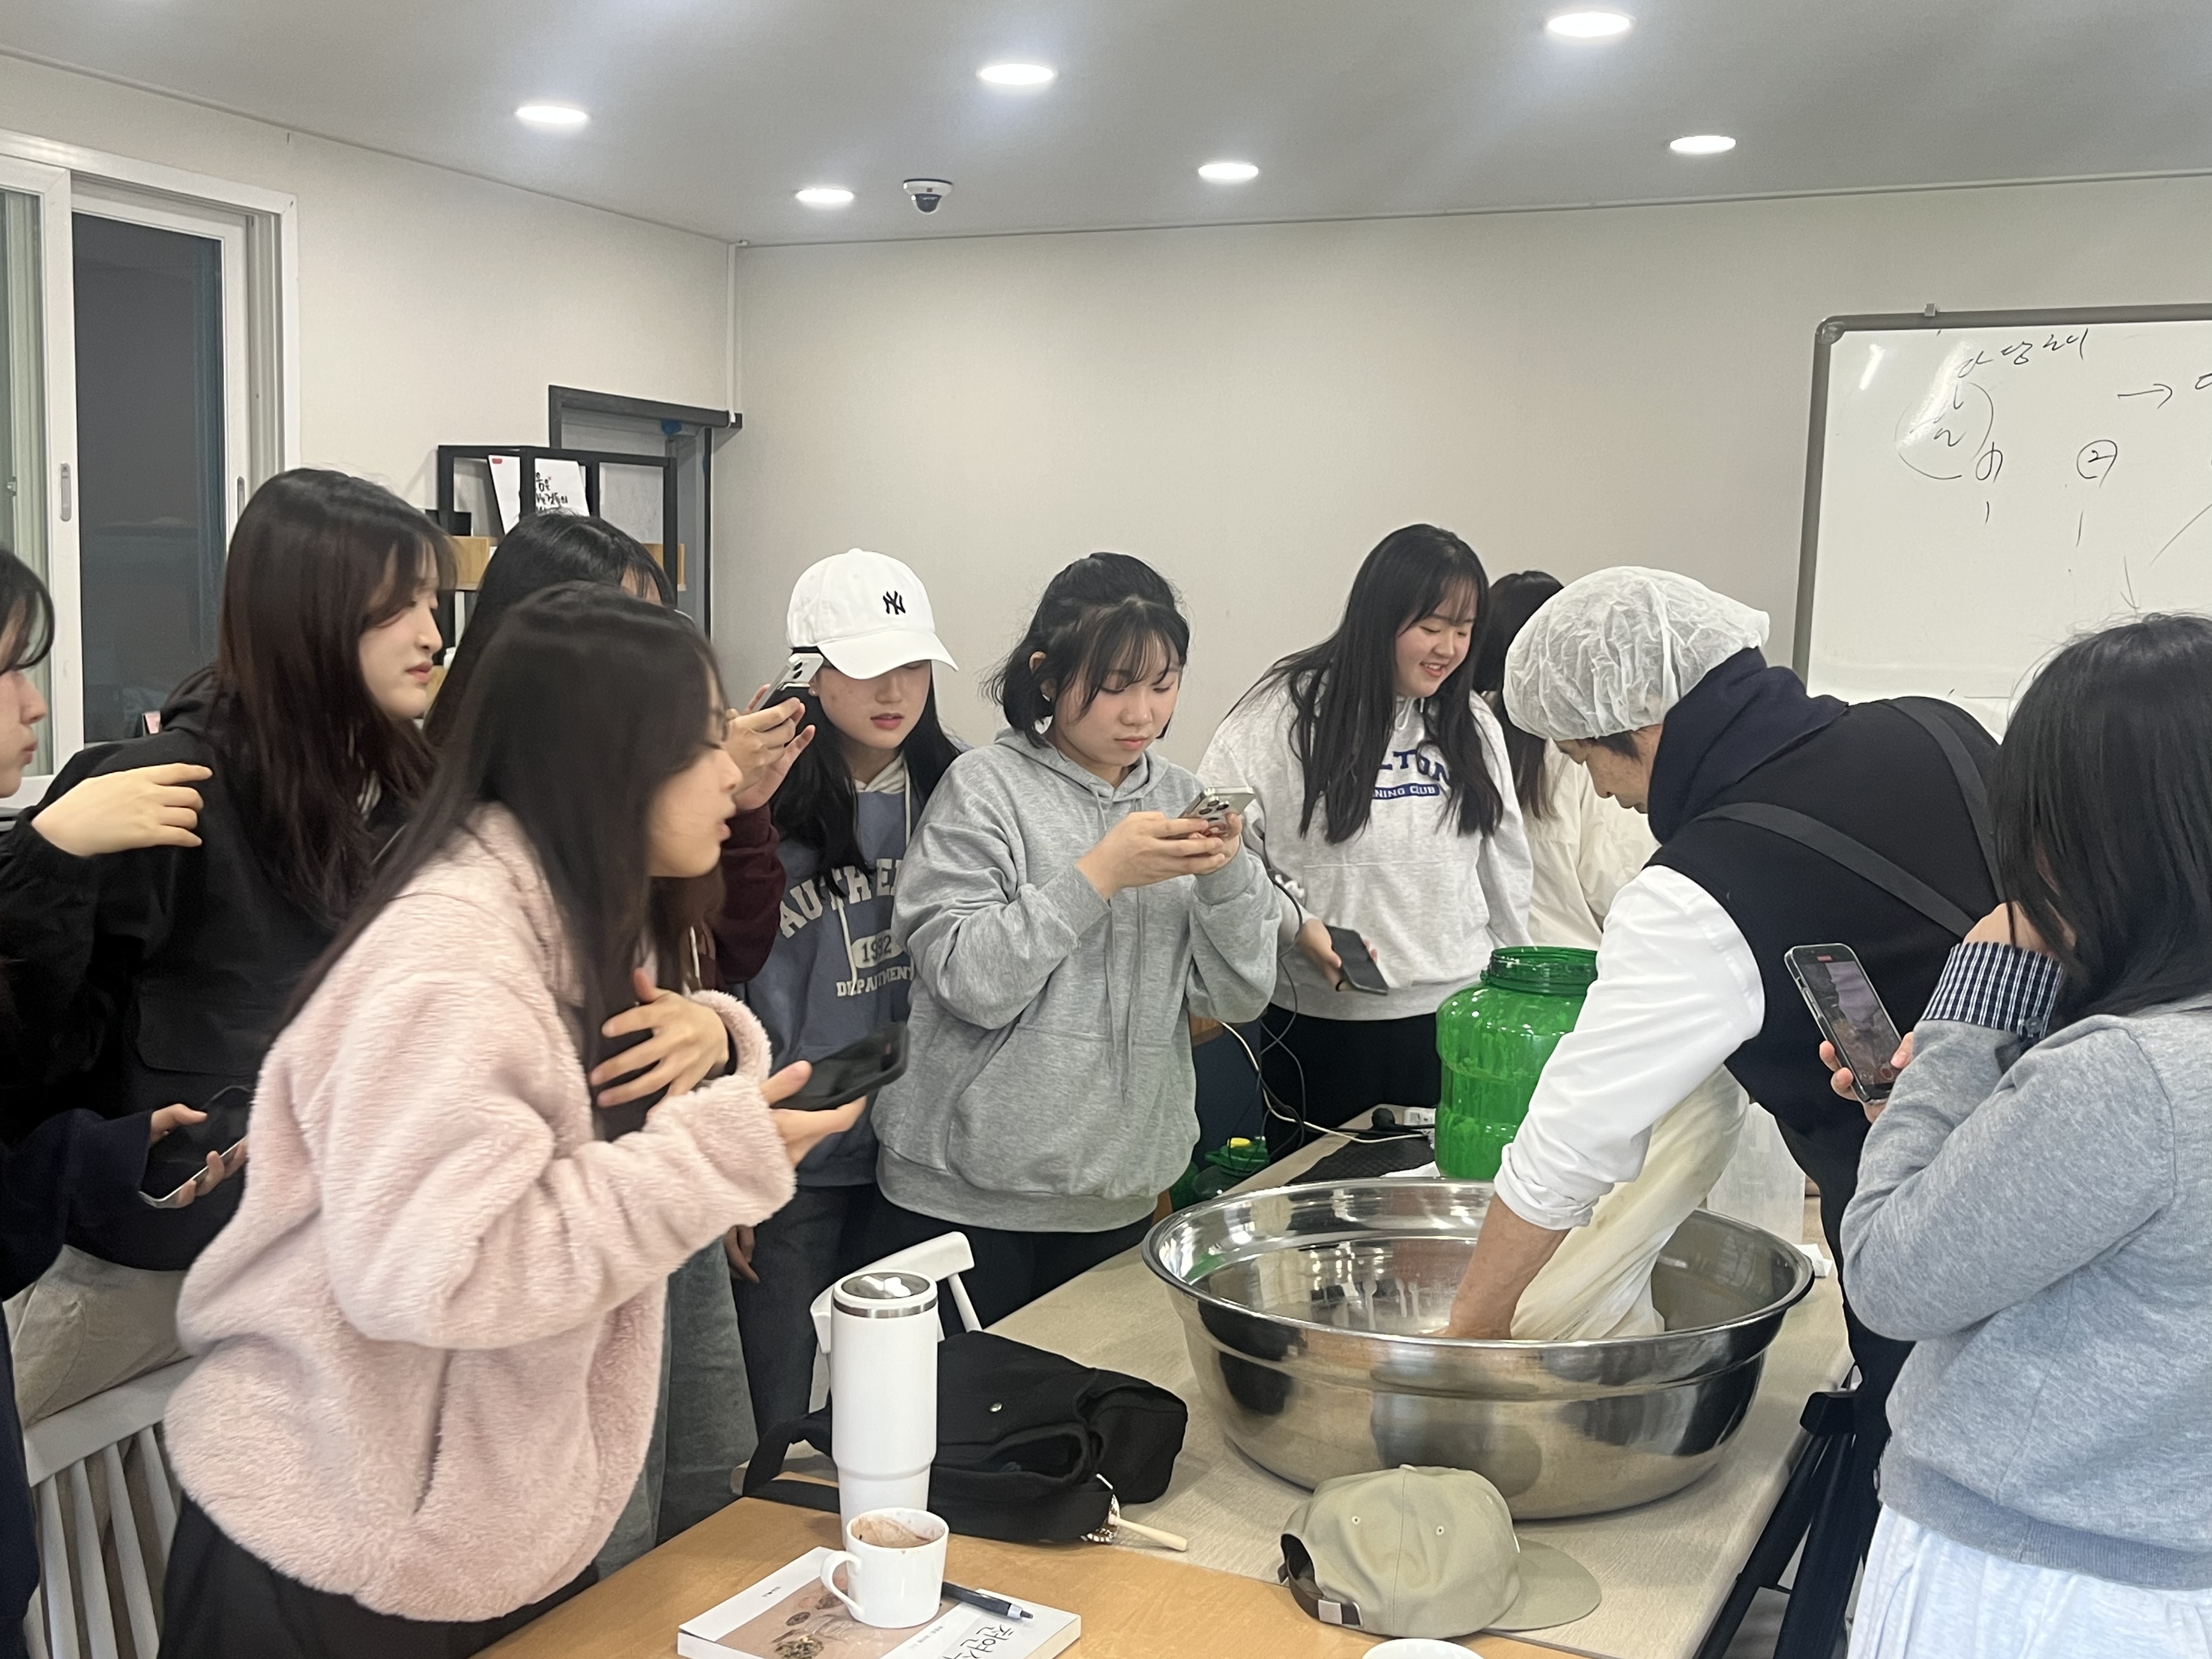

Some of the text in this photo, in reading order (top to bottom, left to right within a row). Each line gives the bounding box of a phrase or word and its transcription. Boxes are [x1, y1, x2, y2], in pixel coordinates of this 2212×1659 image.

[883, 590, 906, 614] NY
[1379, 749, 1449, 785] TON
[1410, 786, 1435, 794] CLUB
[780, 859, 902, 938] AUTHE
[862, 935, 891, 962] 1992
